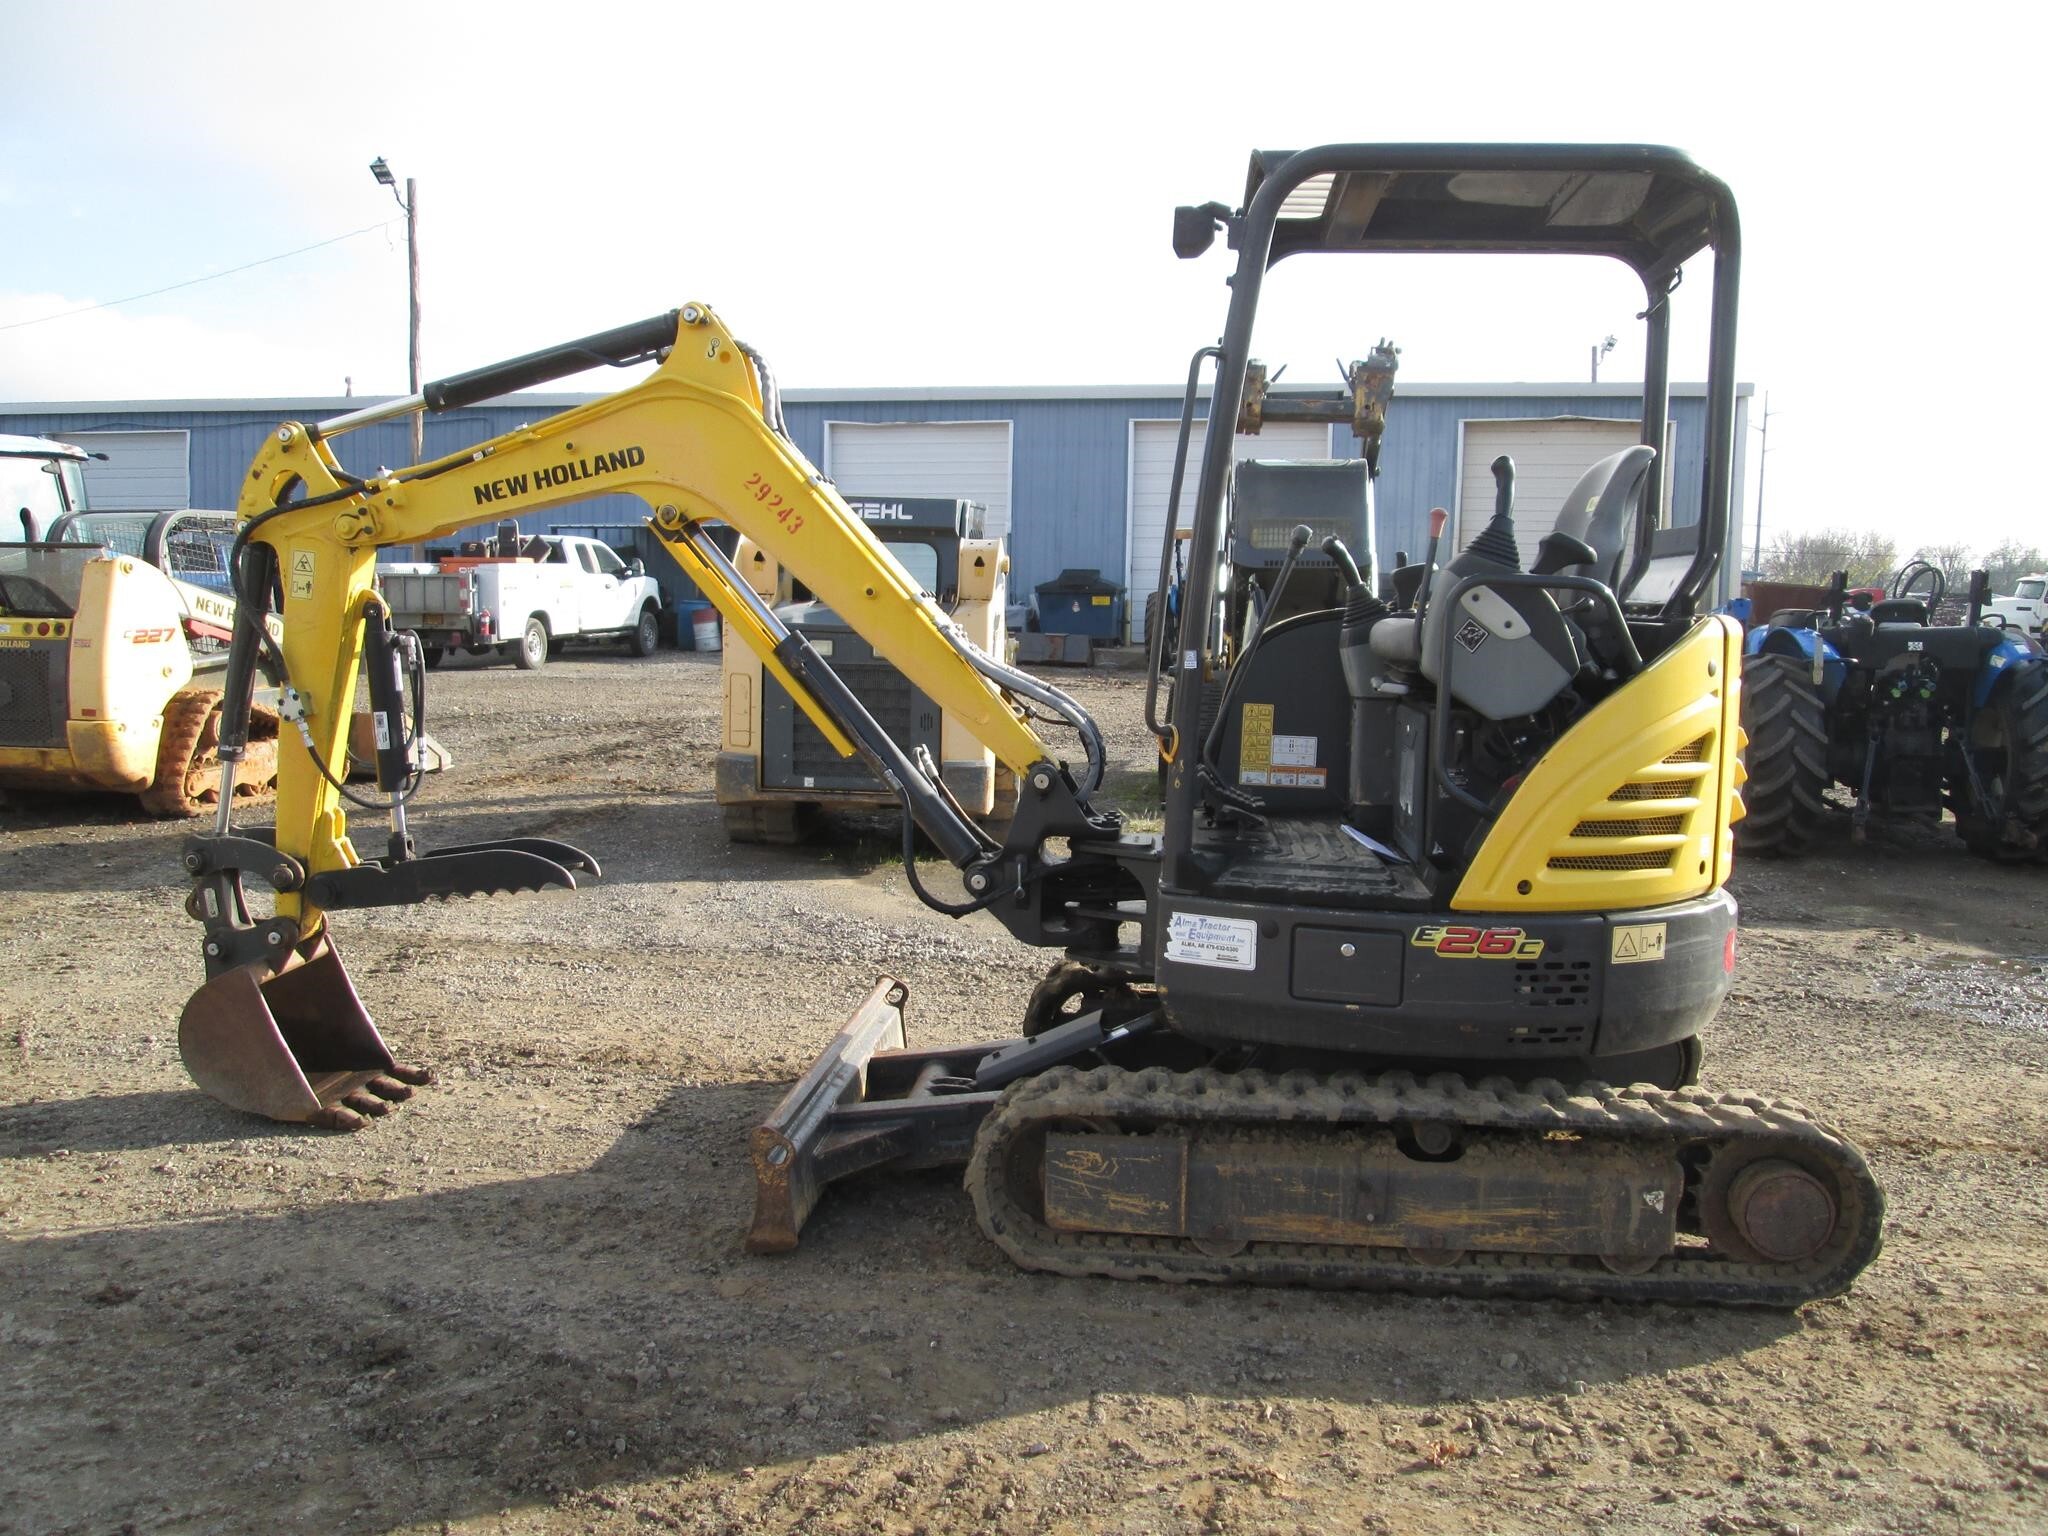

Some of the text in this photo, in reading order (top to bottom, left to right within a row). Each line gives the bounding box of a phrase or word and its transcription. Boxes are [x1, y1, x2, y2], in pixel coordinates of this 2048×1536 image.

[473, 446, 646, 505] NEW HOLLAND
[744, 472, 804, 535] 29243
[195, 595, 225, 617] NEW
[1188, 928, 1236, 943] Equipment
[1198, 918, 1231, 931] Tractor
